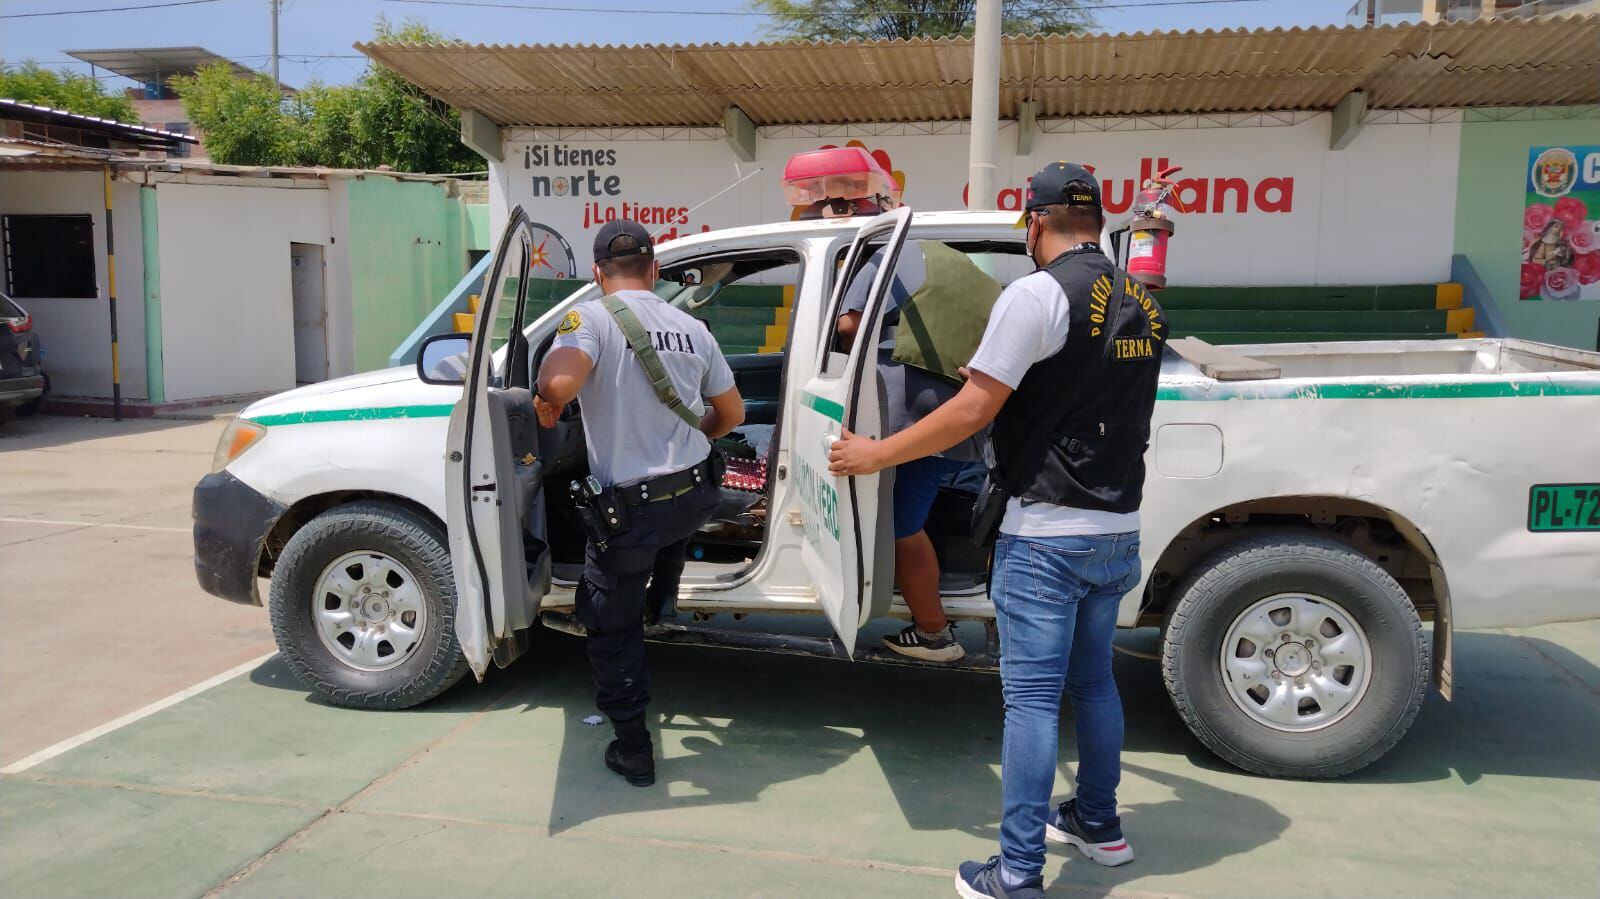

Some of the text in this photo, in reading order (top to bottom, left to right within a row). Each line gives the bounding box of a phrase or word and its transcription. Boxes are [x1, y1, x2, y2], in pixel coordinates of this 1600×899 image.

[525, 145, 617, 170] ¡Si tienes
[622, 202, 689, 225] tienes
[1125, 277, 1162, 341] ACIONAL
[1115, 338, 1153, 359] TERNA
